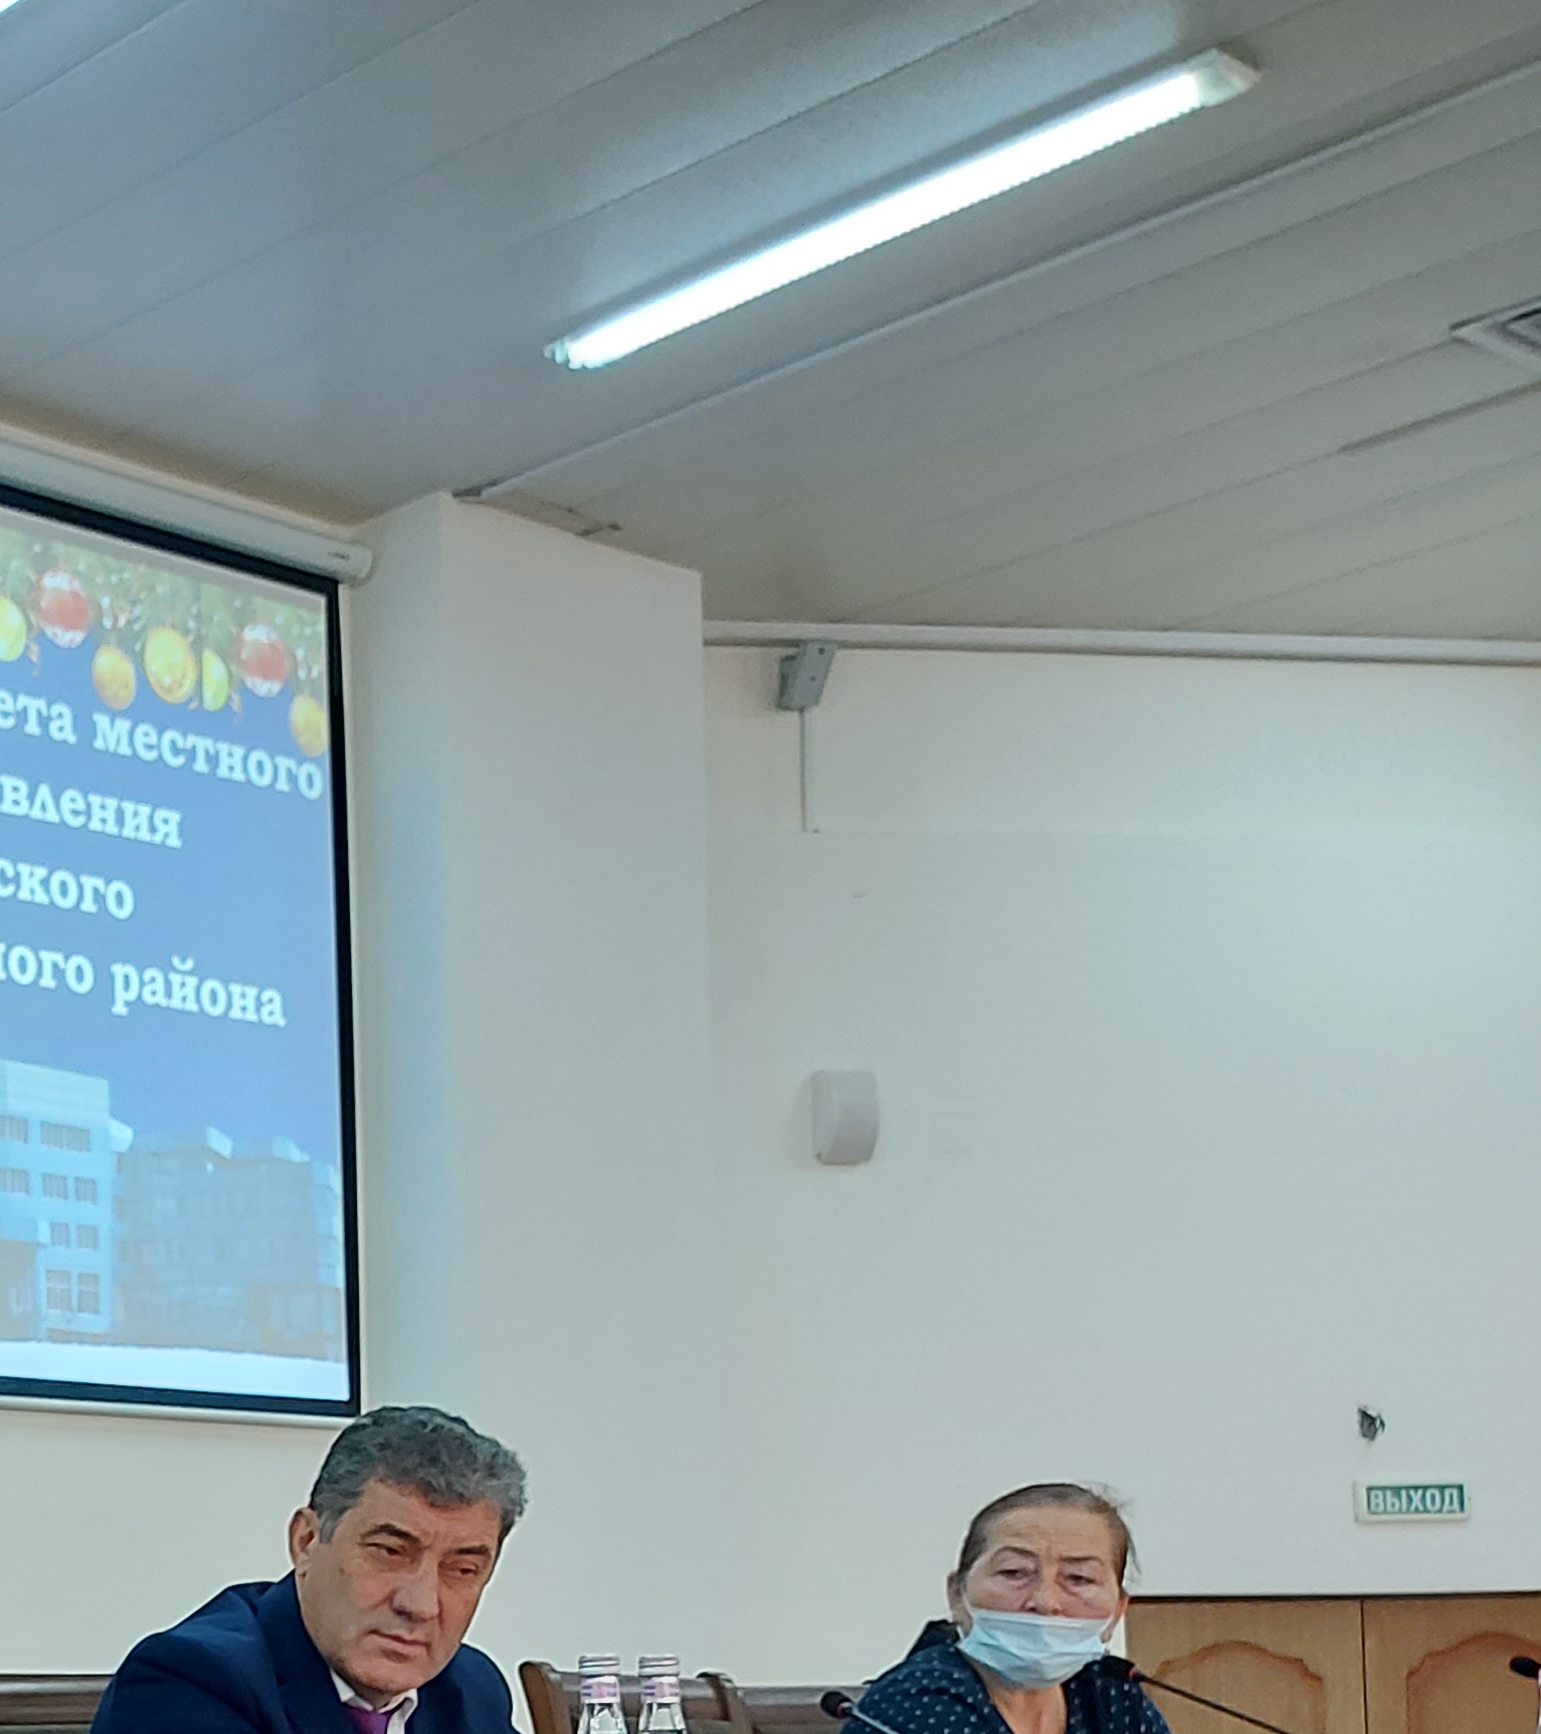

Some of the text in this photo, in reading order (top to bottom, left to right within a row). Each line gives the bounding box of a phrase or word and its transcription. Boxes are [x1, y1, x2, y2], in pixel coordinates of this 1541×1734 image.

[92, 712, 324, 800] местного
[110, 954, 287, 1028] района
[1369, 1488, 1460, 1513] ВЫХОД
